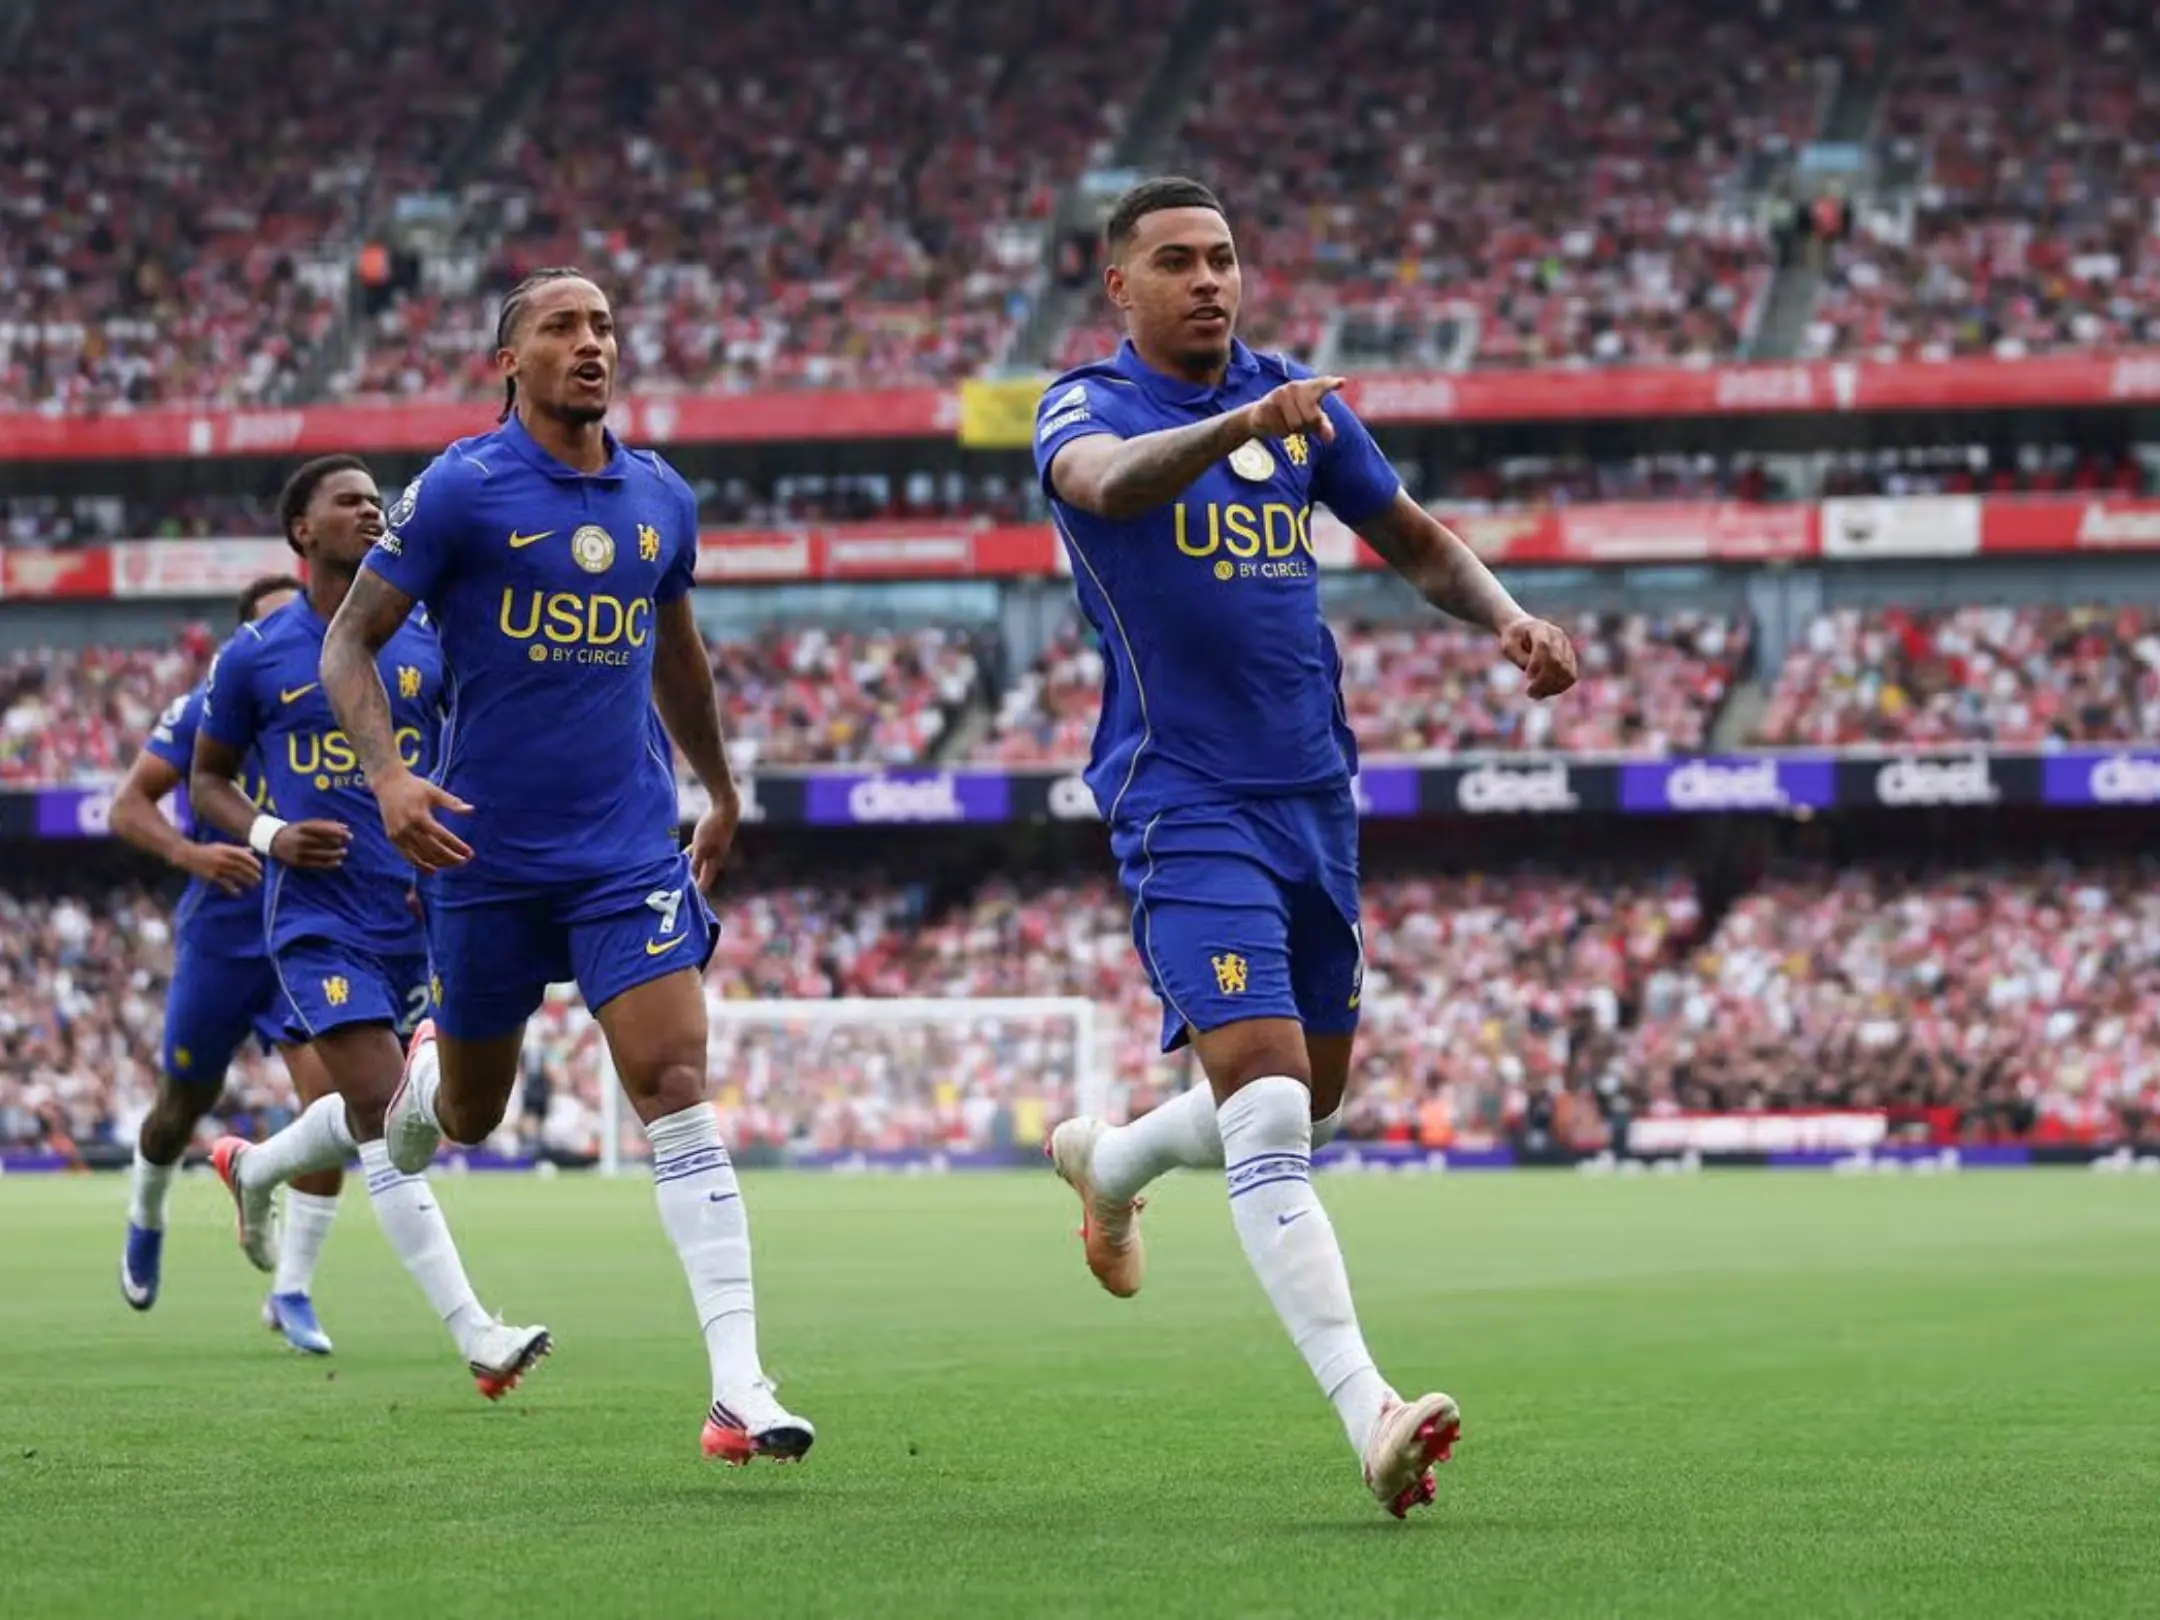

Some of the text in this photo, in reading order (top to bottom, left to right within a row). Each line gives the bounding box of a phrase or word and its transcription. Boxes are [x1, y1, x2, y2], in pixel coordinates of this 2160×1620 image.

[1239, 562, 1308, 578] BY CIRCLE
[500, 586, 648, 647] USDC
[552, 647, 630, 666] BY CIRCLE
[288, 727, 421, 773] USC
[645, 889, 682, 933] 9
